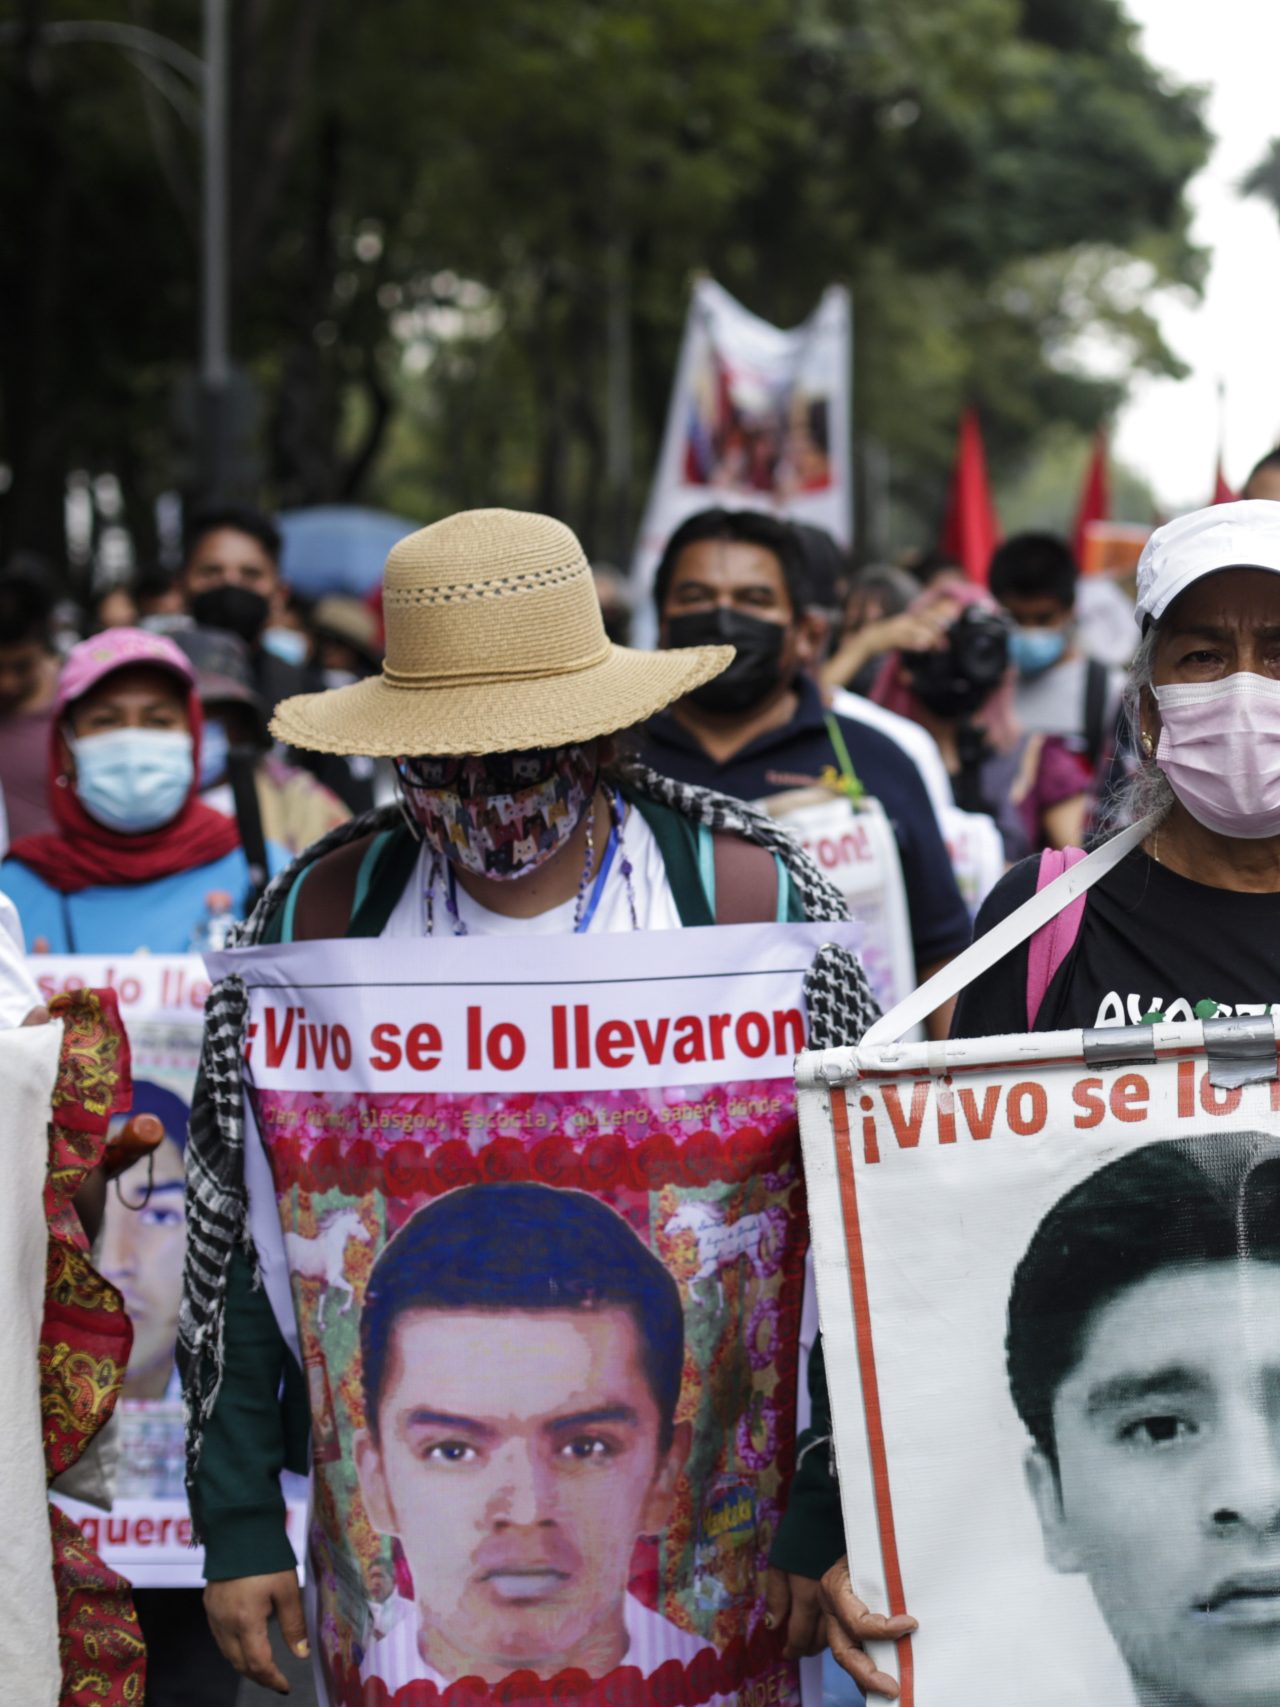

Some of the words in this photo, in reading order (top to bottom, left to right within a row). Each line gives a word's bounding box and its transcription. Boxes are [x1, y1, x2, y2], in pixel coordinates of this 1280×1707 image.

[369, 1021, 444, 1072] se
[466, 1005, 526, 1071] lo
[551, 1004, 807, 1070] llevaron
[361, 1108, 447, 1134] Glasgow,
[463, 1109, 558, 1132] Escocia,
[572, 1108, 649, 1137] quiero
[859, 1073, 1049, 1165] ¡Vivo
[1071, 1072, 1151, 1130] se
[1177, 1060, 1243, 1119] lo
